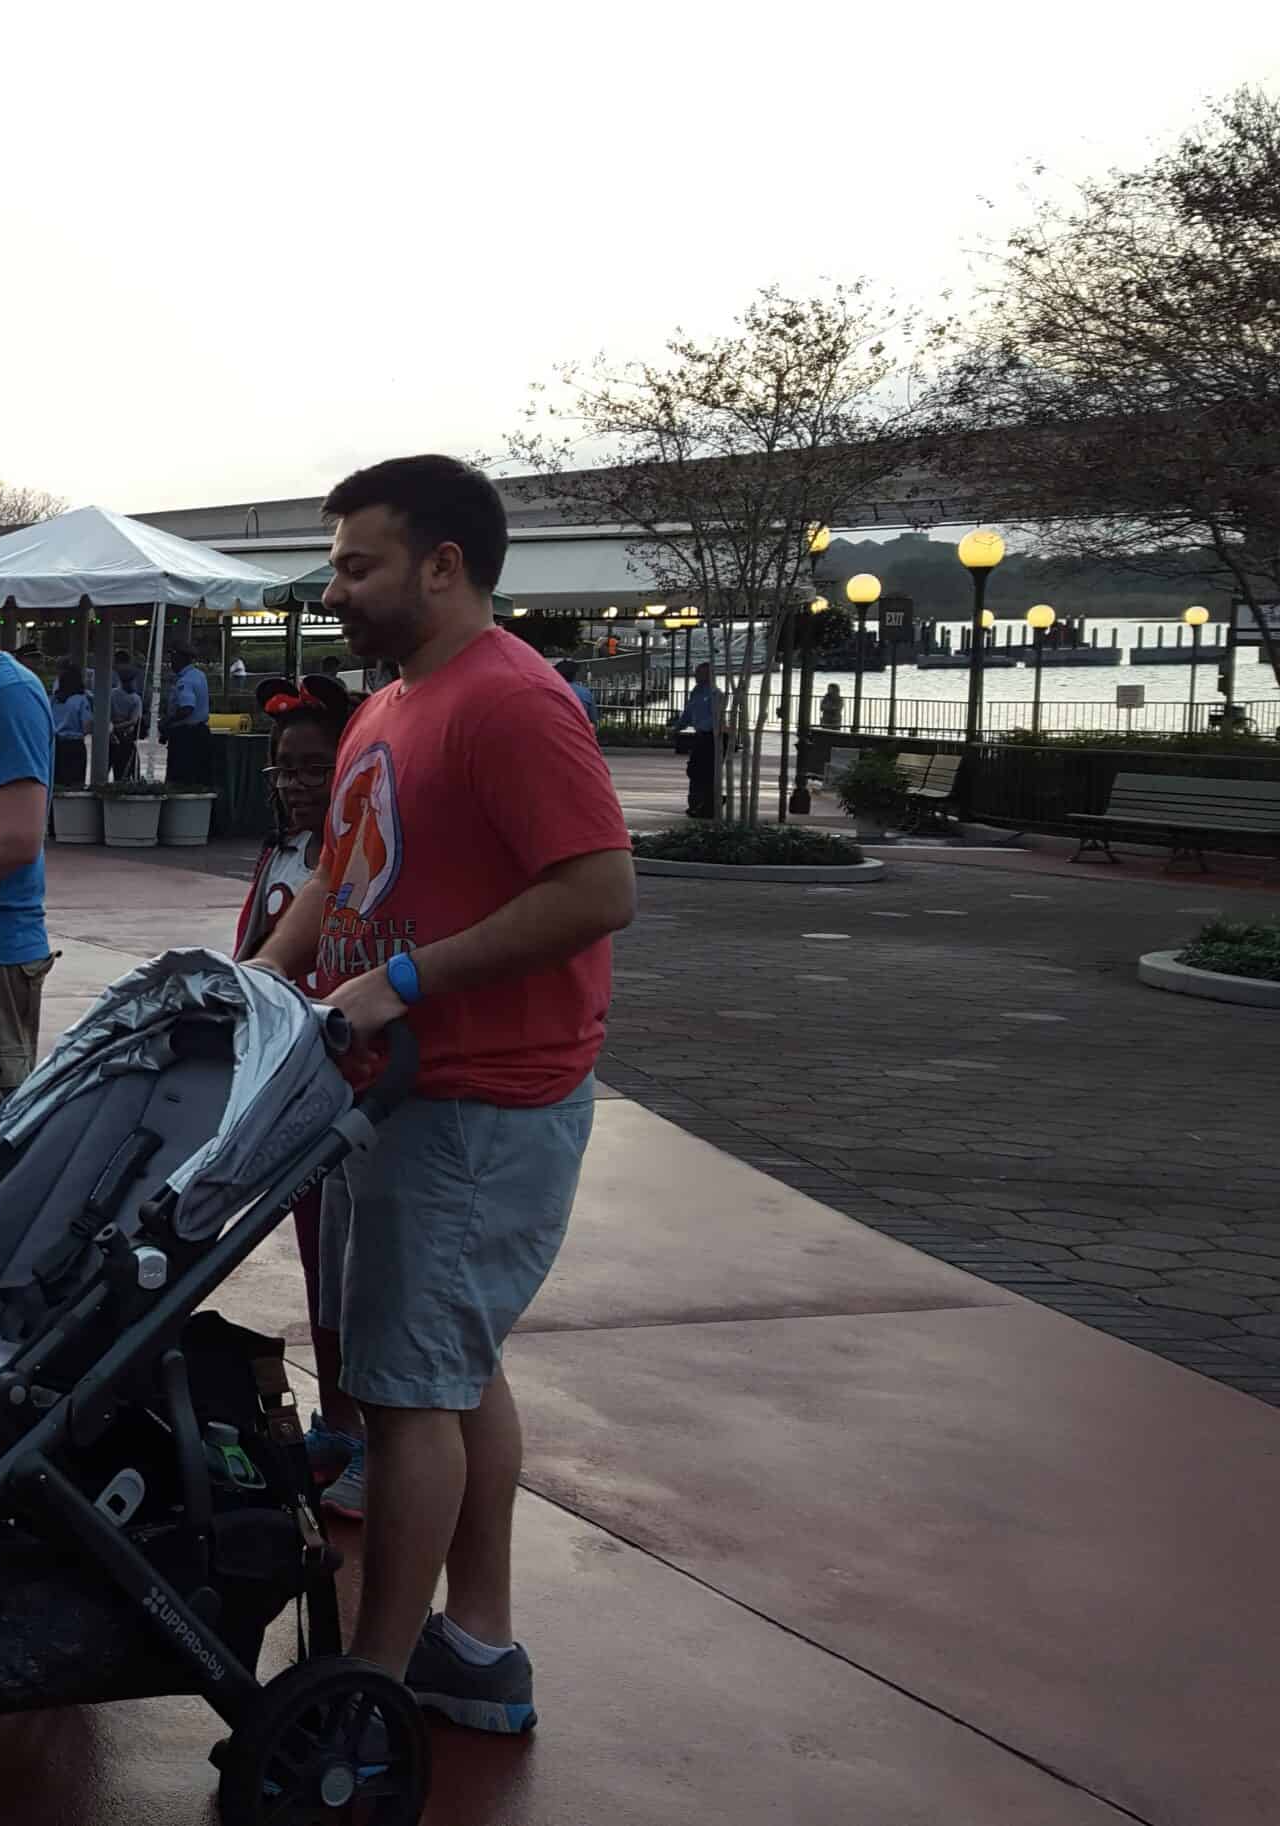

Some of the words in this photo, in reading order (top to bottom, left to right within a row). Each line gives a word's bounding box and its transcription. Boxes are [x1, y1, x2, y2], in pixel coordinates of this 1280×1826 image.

[885, 611, 905, 626] EXIT
[343, 918, 417, 935] LITTLE
[280, 1166, 329, 1210] VISTA
